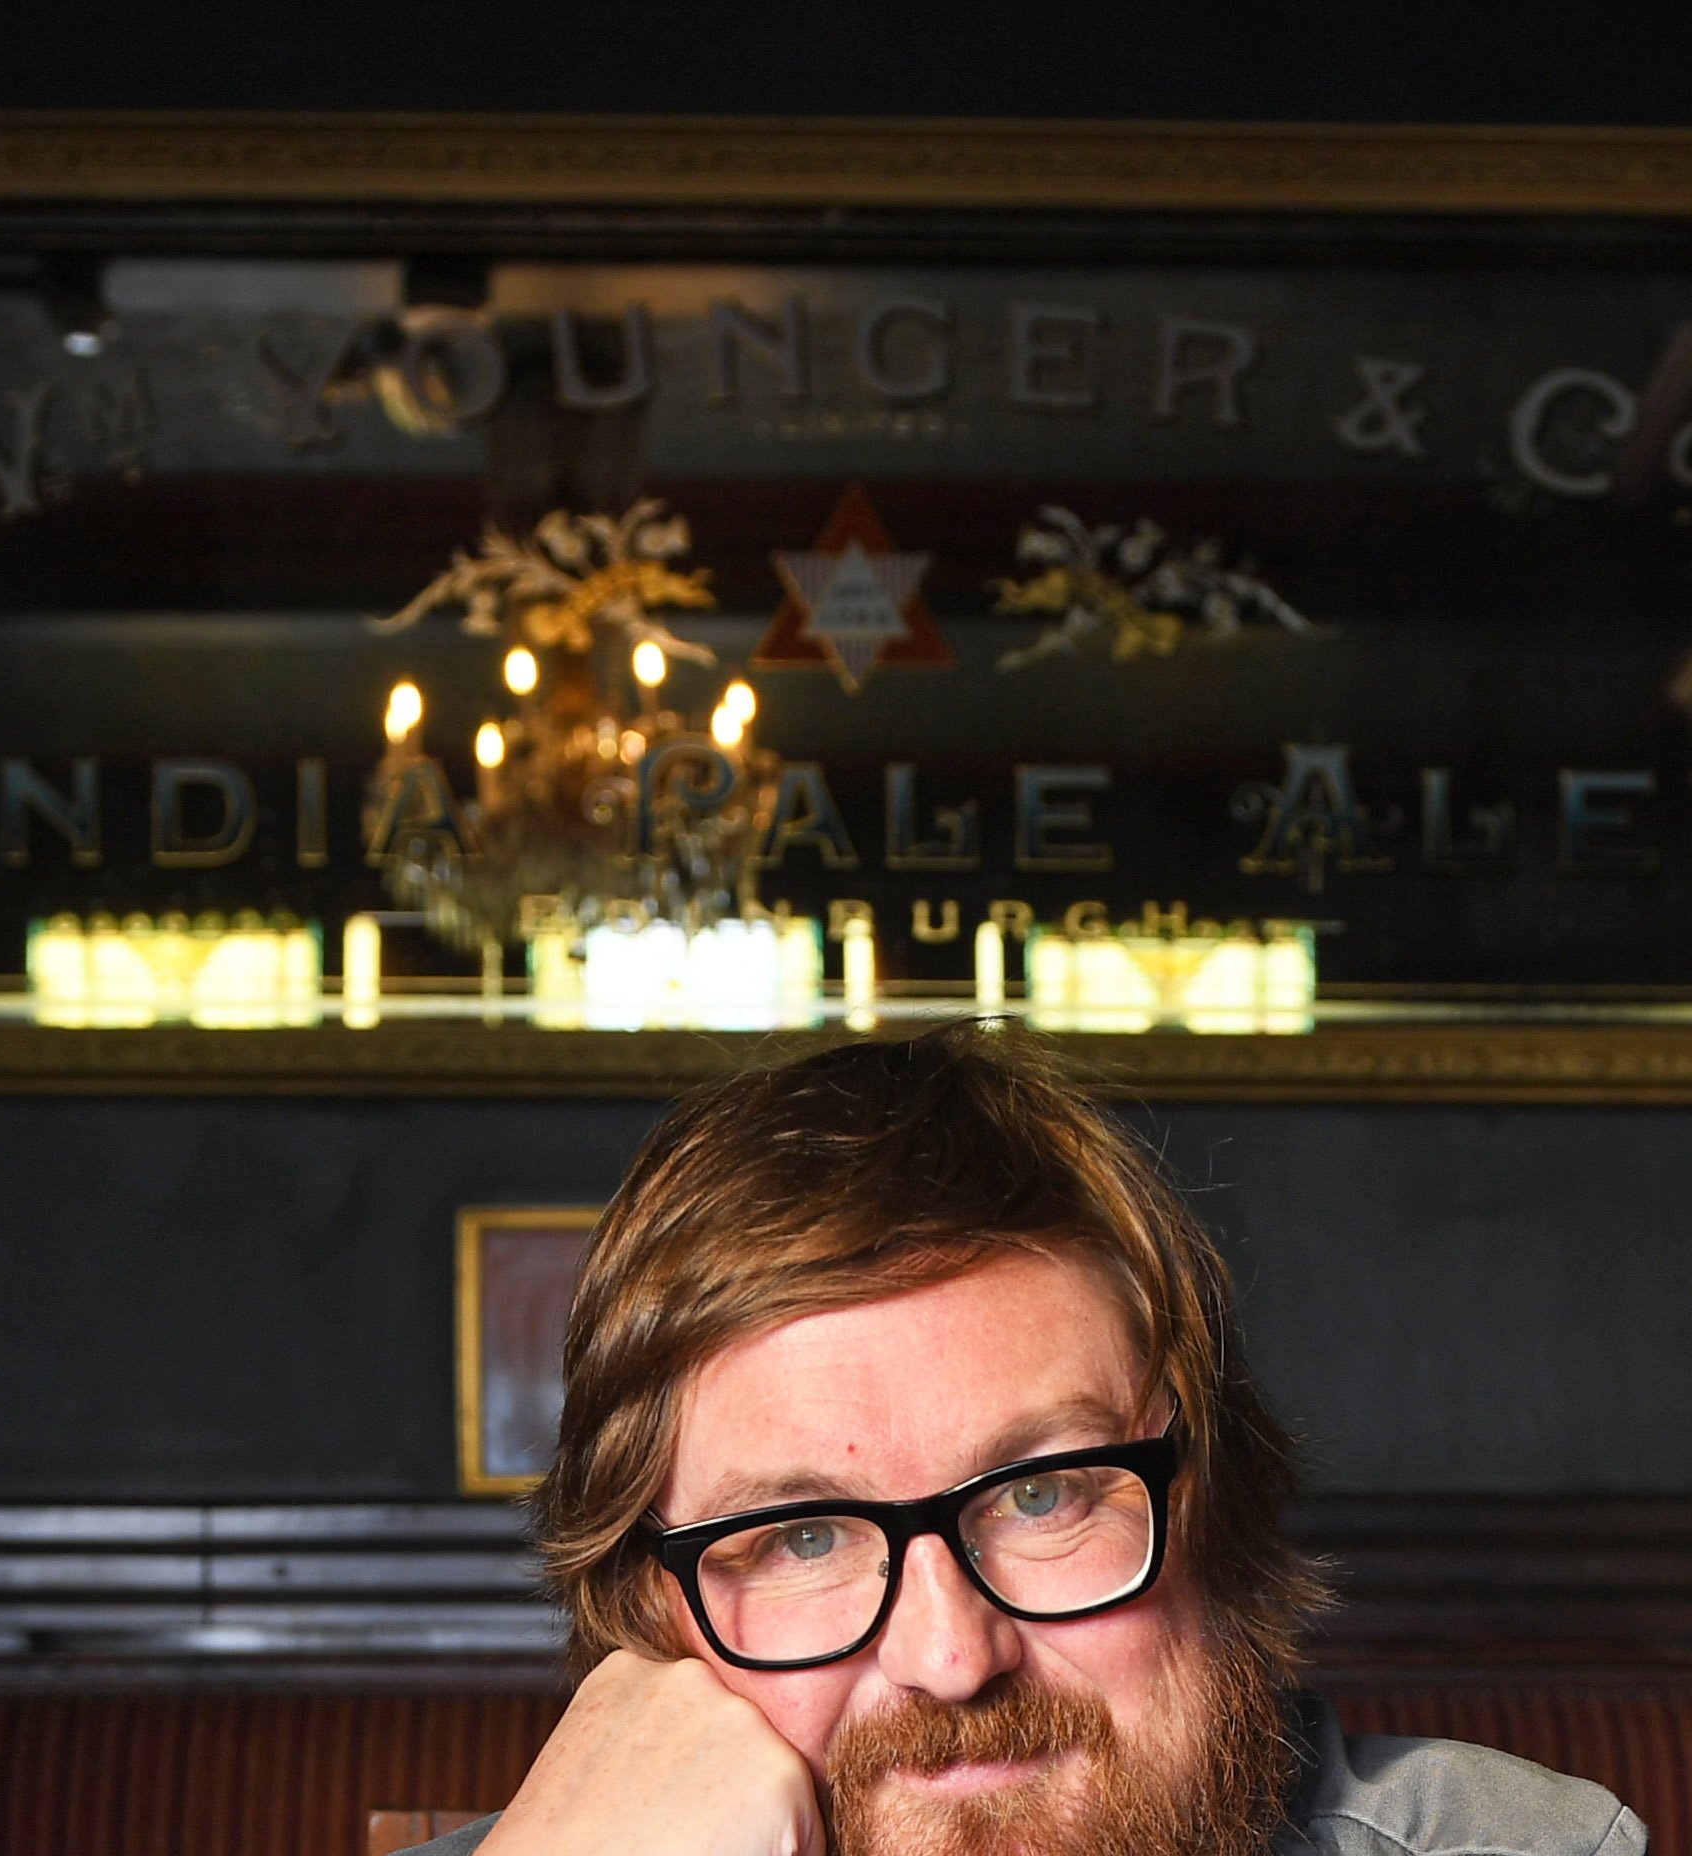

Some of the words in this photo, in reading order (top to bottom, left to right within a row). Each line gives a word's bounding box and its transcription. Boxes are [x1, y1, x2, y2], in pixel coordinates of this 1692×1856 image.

[256, 296, 1260, 454] YOUNGER
[1334, 353, 1429, 458] &
[630, 738, 1116, 872] PALE
